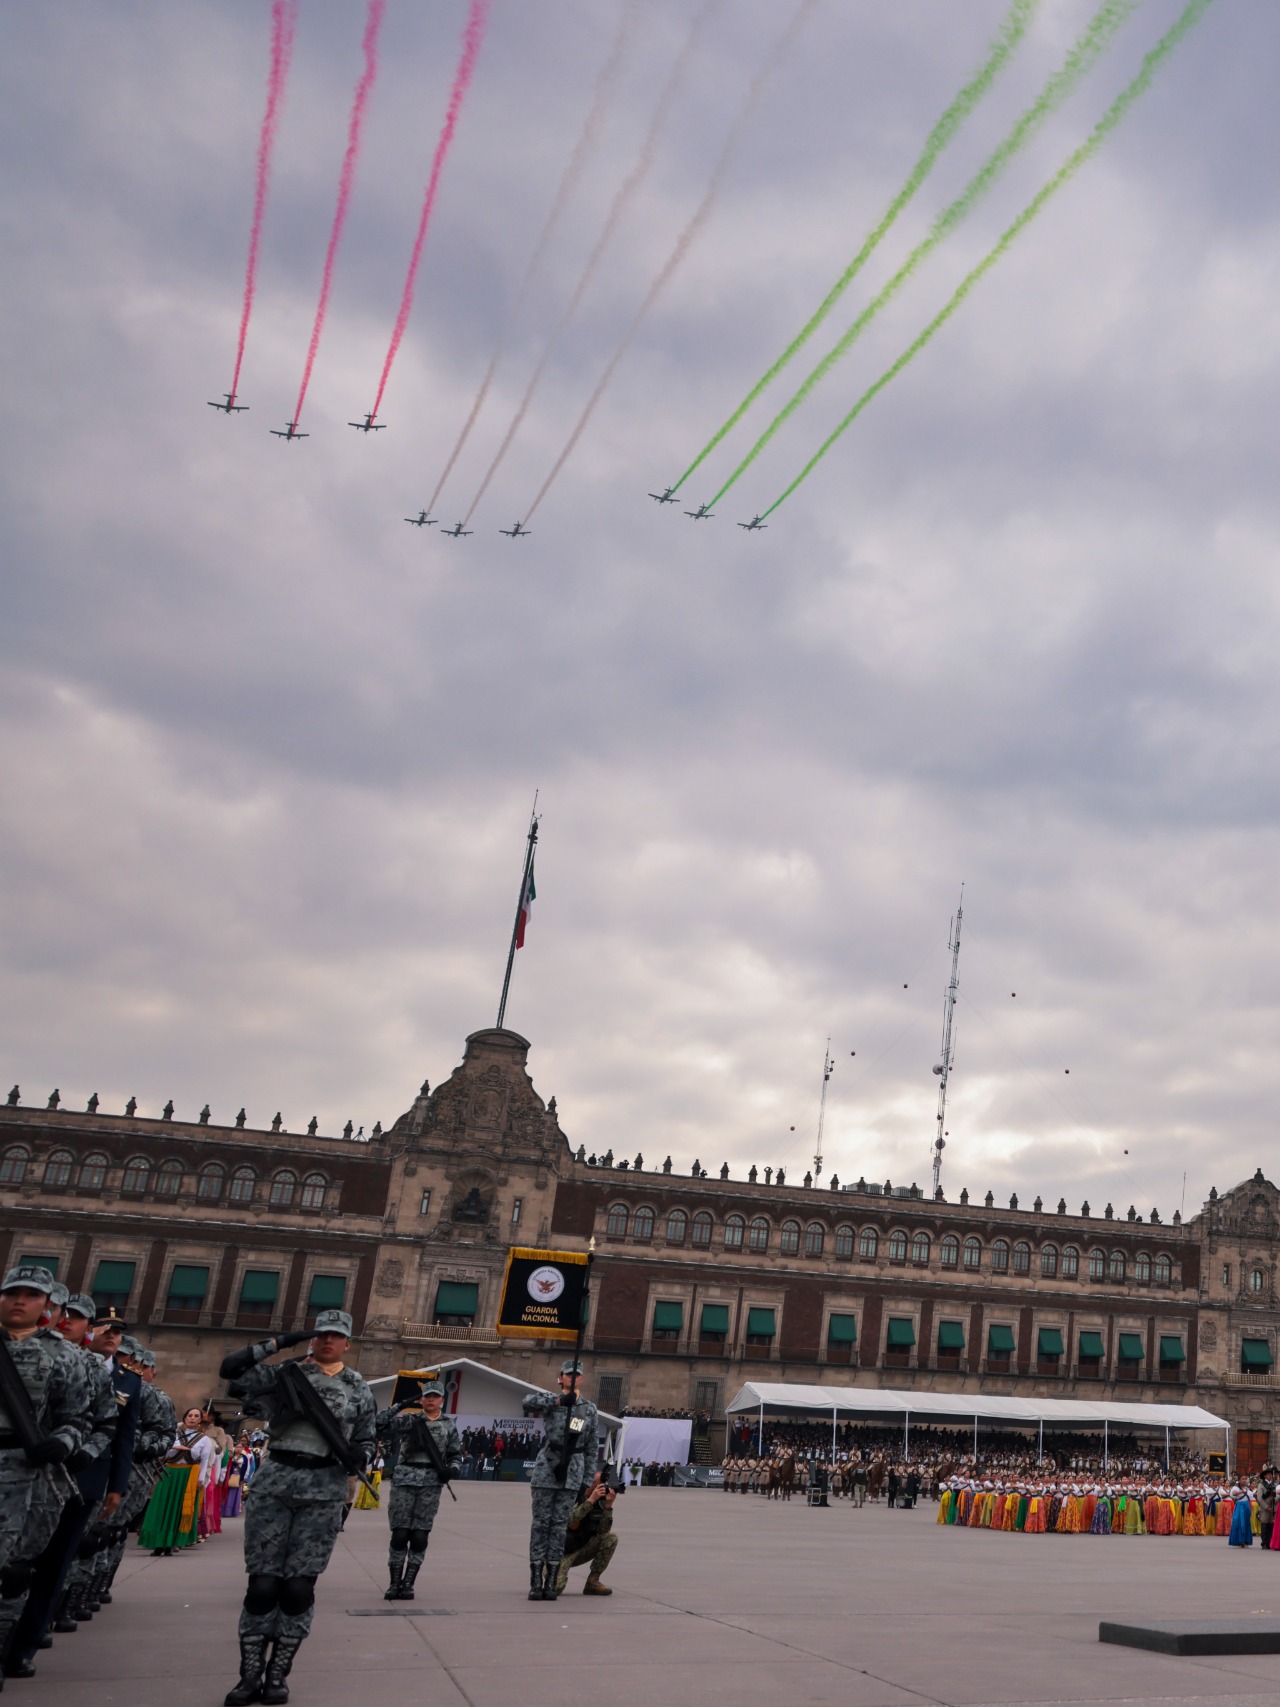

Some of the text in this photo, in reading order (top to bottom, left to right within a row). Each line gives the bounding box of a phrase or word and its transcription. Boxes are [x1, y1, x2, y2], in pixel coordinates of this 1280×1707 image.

[525, 1305, 558, 1315] GUARDIA
[521, 1314, 559, 1323] NACIONAL
[492, 1418, 535, 1429] Mexicana
